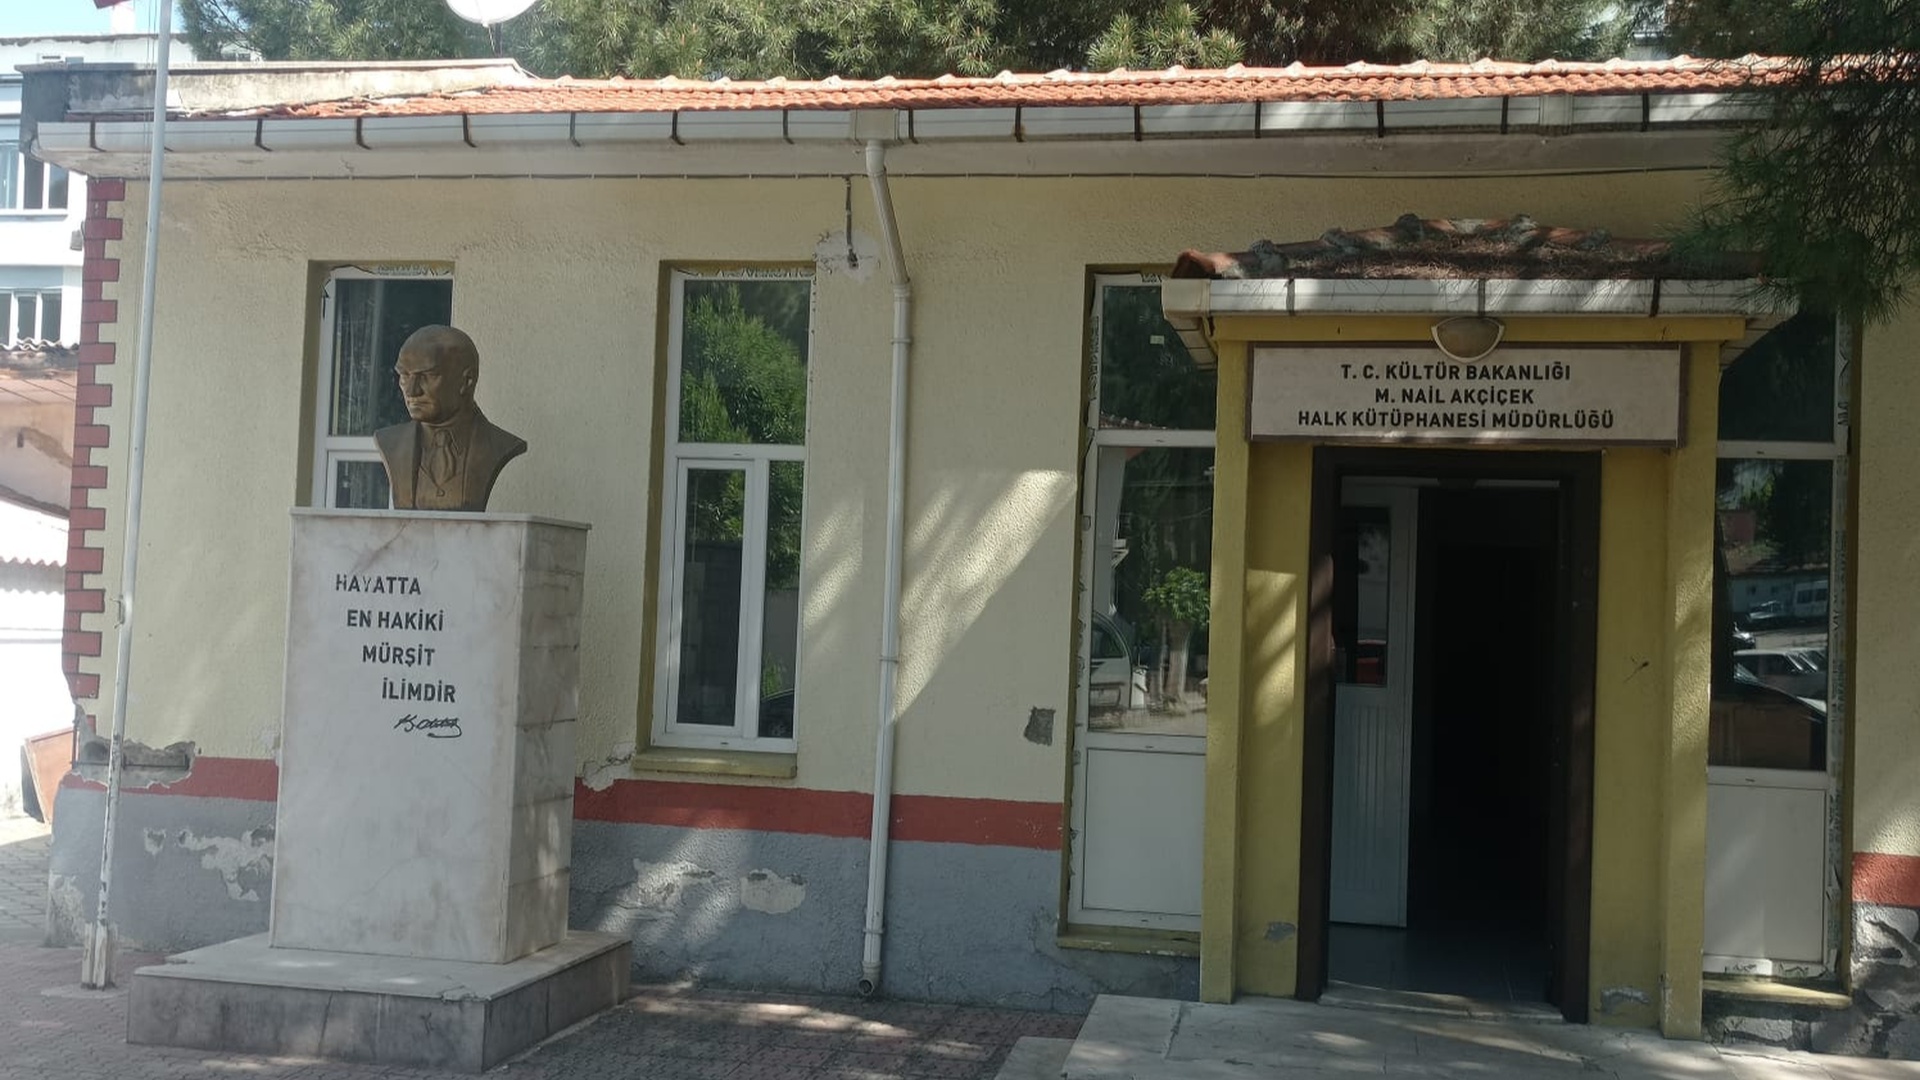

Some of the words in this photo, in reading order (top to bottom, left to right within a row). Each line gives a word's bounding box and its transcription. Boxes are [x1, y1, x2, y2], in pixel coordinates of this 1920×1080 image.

[1340, 364, 1357, 380] T.
[1362, 364, 1380, 380] C.
[1385, 361, 1460, 381] KÜLTÜR
[1466, 360, 1571, 381] BAKANLIĞI
[1375, 388, 1396, 404] M.
[1401, 385, 1446, 405] NAİL
[1450, 386, 1534, 406] AKÇİÇEK
[1298, 410, 1347, 427] HALK
[1352, 408, 1486, 428] KÜTÜPHANESİ
[1492, 409, 1614, 430] MÜDÜRLÜĞÜ
[335, 574, 422, 595] HAYATTA
[346, 609, 372, 628] EN
[377, 608, 444, 632] HAKİKİ
[362, 642, 436, 667] MÜRŞİT
[381, 677, 456, 703] İLİMDİR
